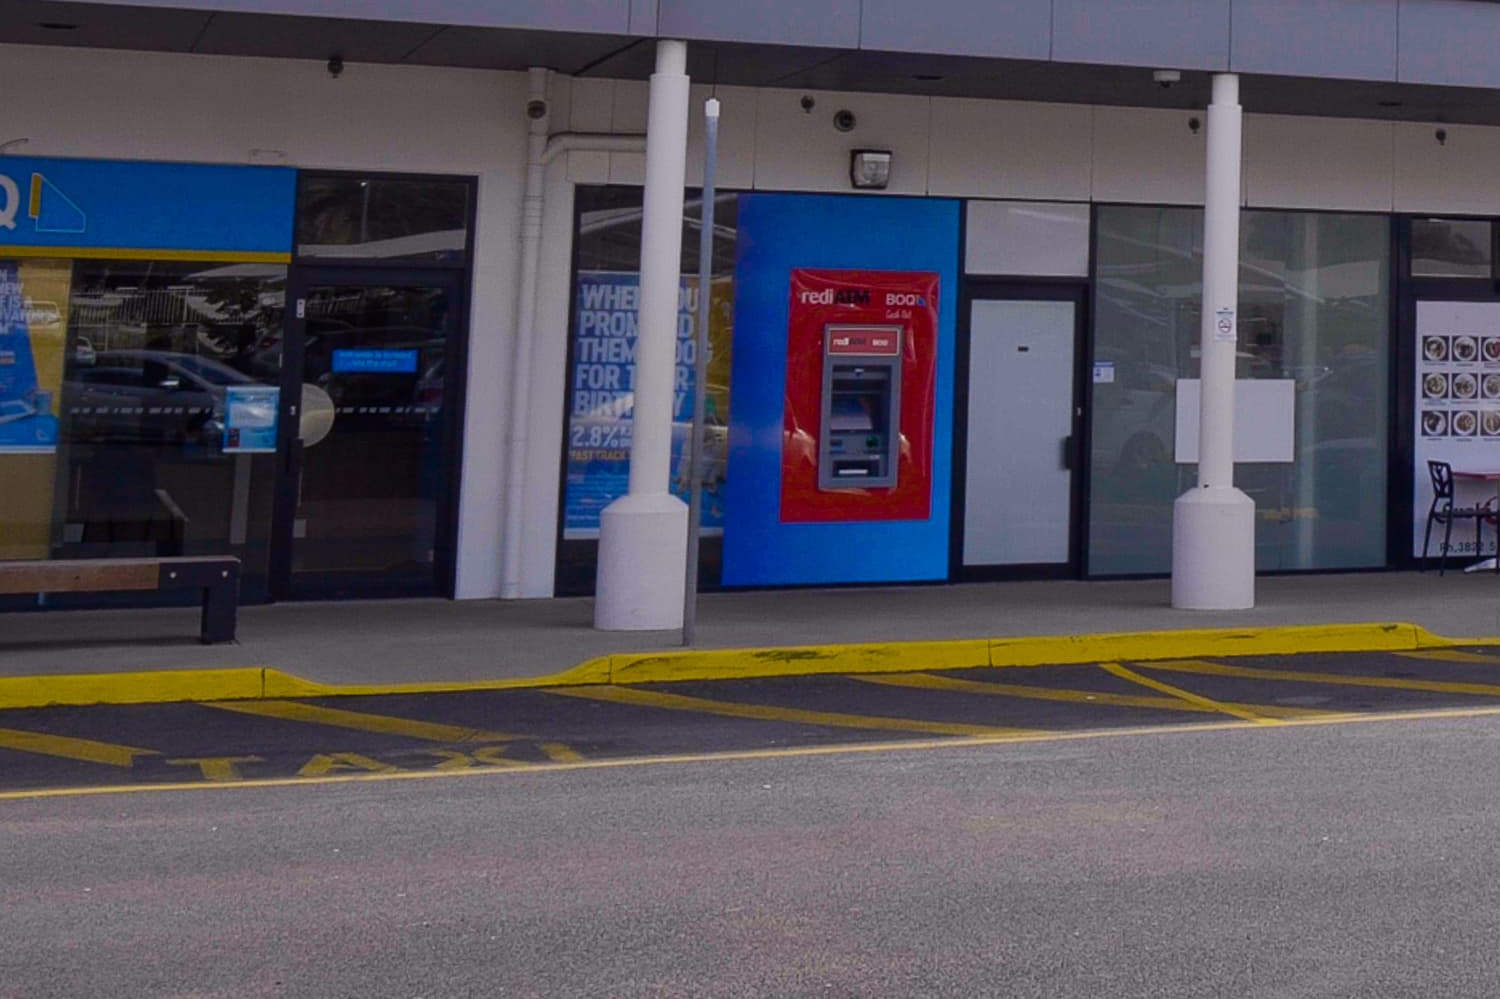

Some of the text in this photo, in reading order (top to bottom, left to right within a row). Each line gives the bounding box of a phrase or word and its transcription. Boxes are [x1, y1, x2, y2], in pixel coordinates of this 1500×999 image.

[574, 364, 620, 390] FOR
[572, 425, 618, 448] 2.8%
[165, 742, 586, 781] TAXI
